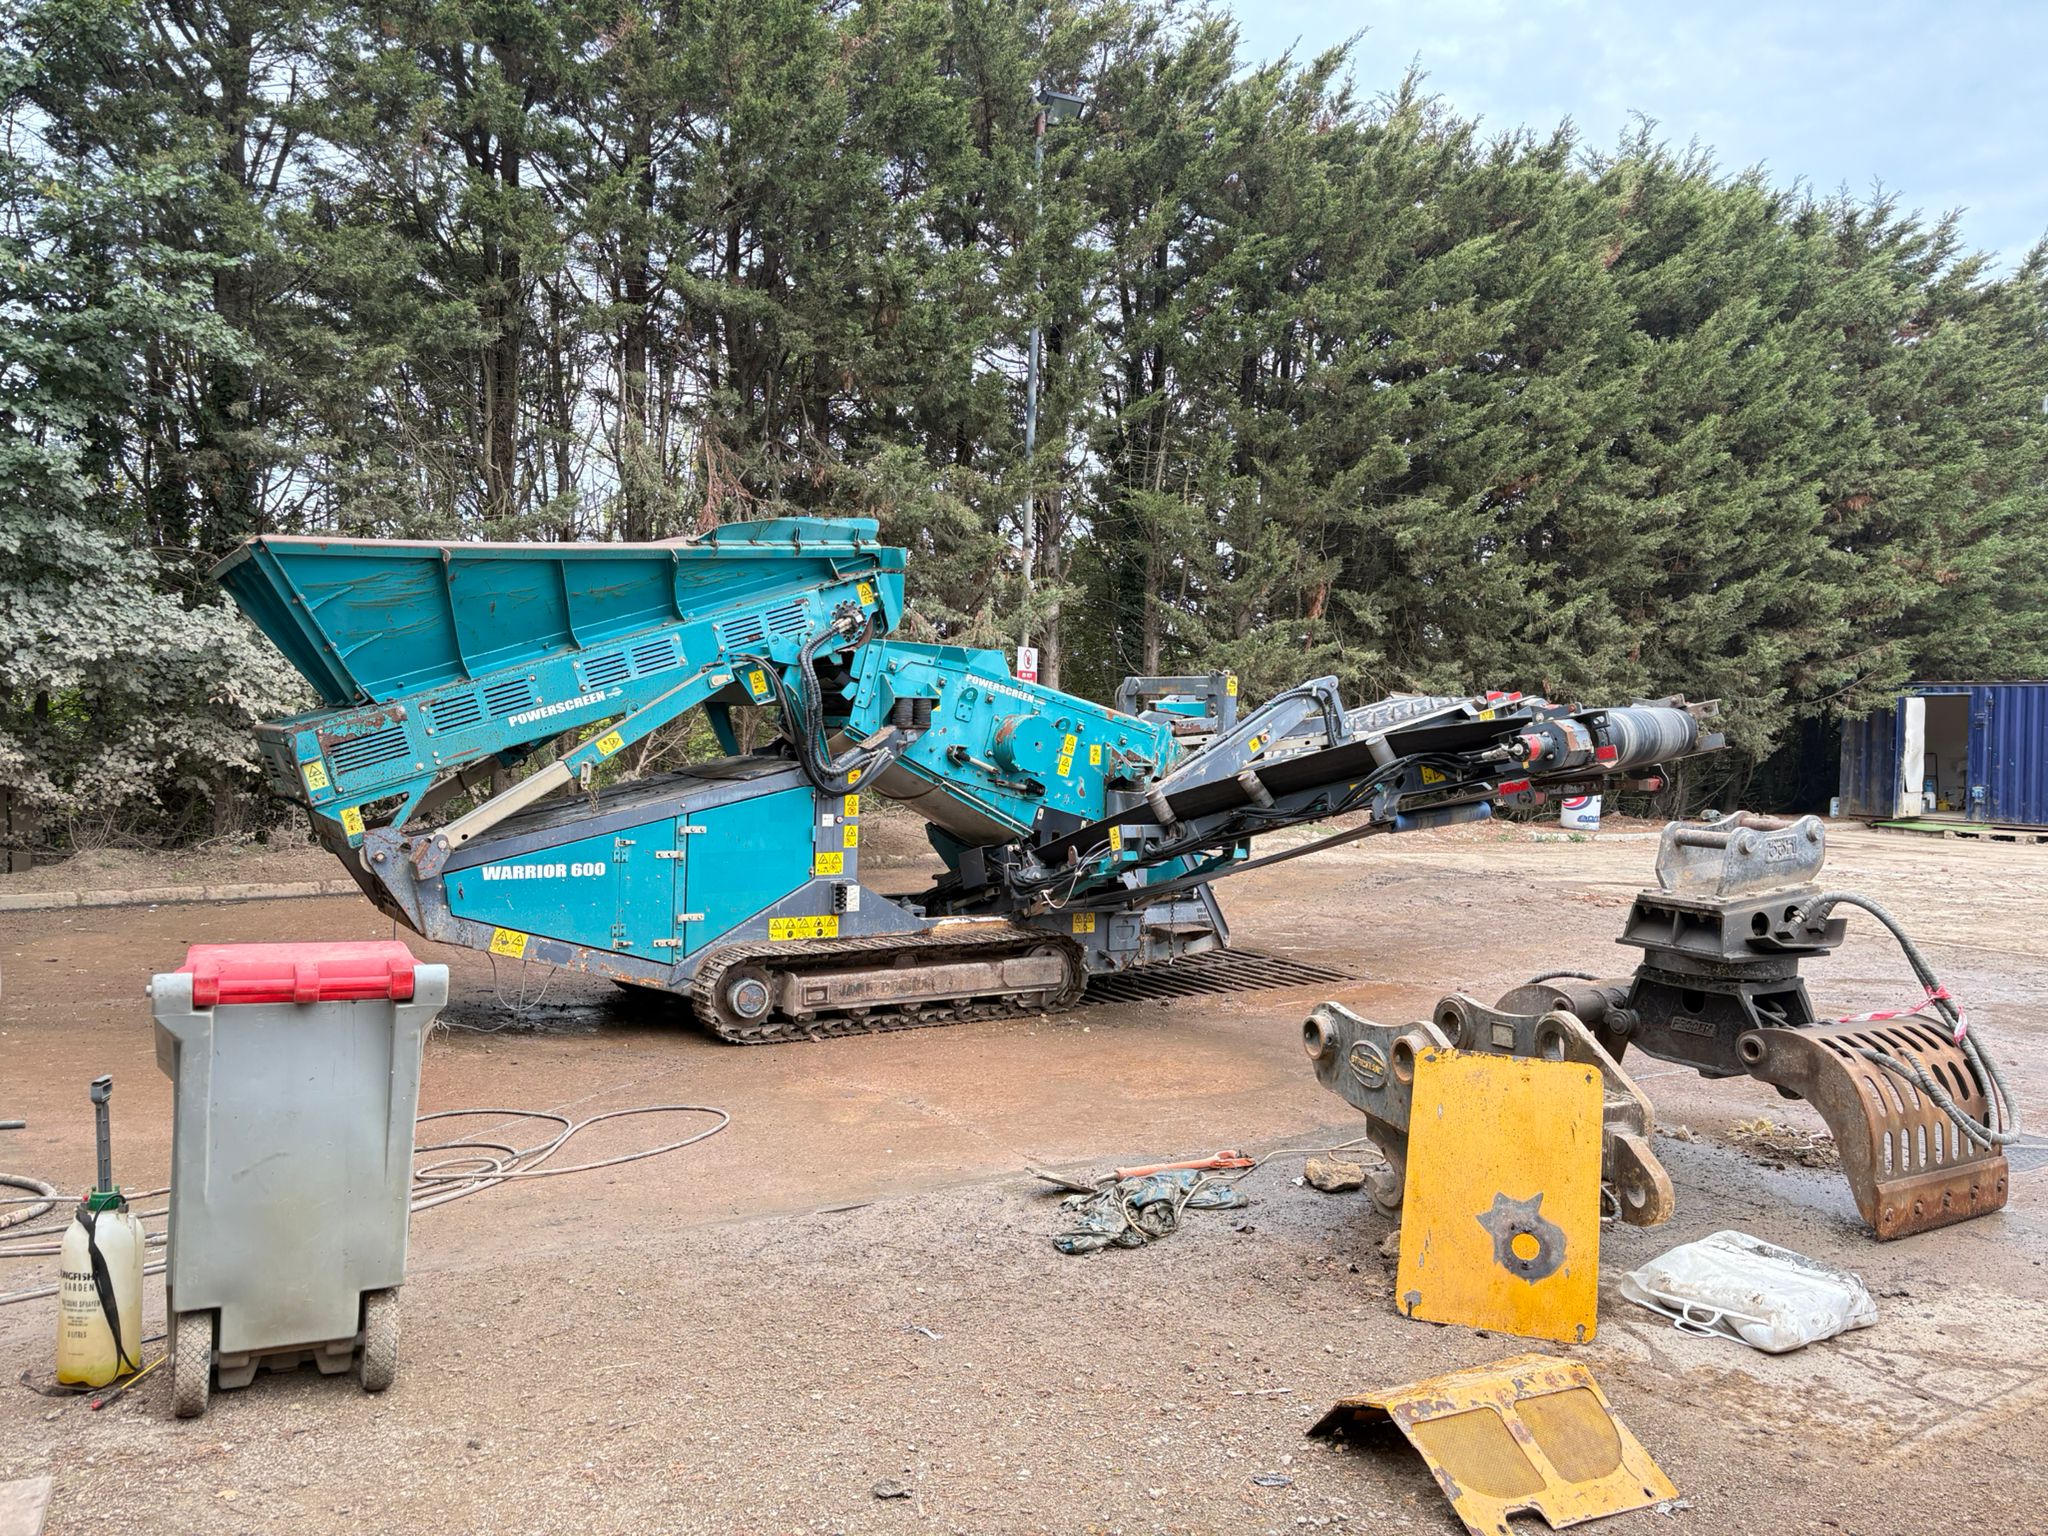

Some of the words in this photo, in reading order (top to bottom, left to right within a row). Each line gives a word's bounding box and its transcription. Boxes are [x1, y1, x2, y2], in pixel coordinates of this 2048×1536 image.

[966, 673, 1035, 703] POWERSCREEN
[508, 690, 606, 727] POWERSCREEN
[482, 863, 567, 881] WARRIOR
[571, 862, 606, 877] 600
